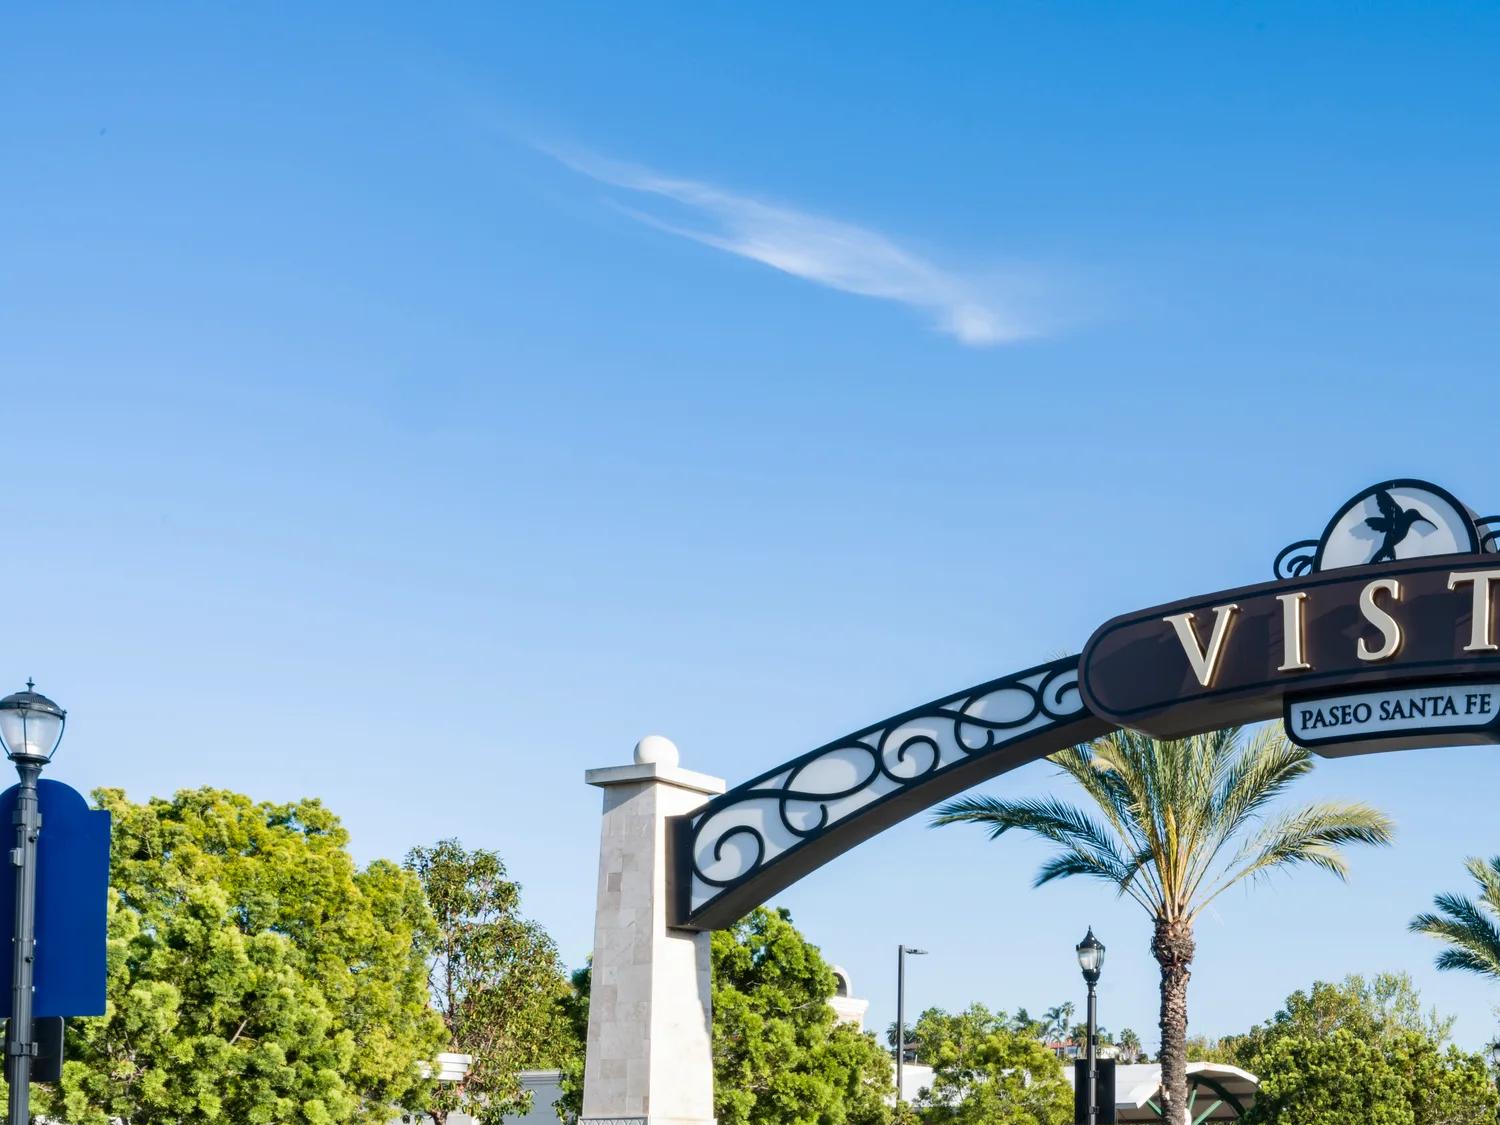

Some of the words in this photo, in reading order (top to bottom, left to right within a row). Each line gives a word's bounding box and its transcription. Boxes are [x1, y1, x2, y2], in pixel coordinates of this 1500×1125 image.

[1300, 703, 1372, 730] PASEO
[1379, 695, 1459, 720] SANTA
[1465, 693, 1492, 714] FE
